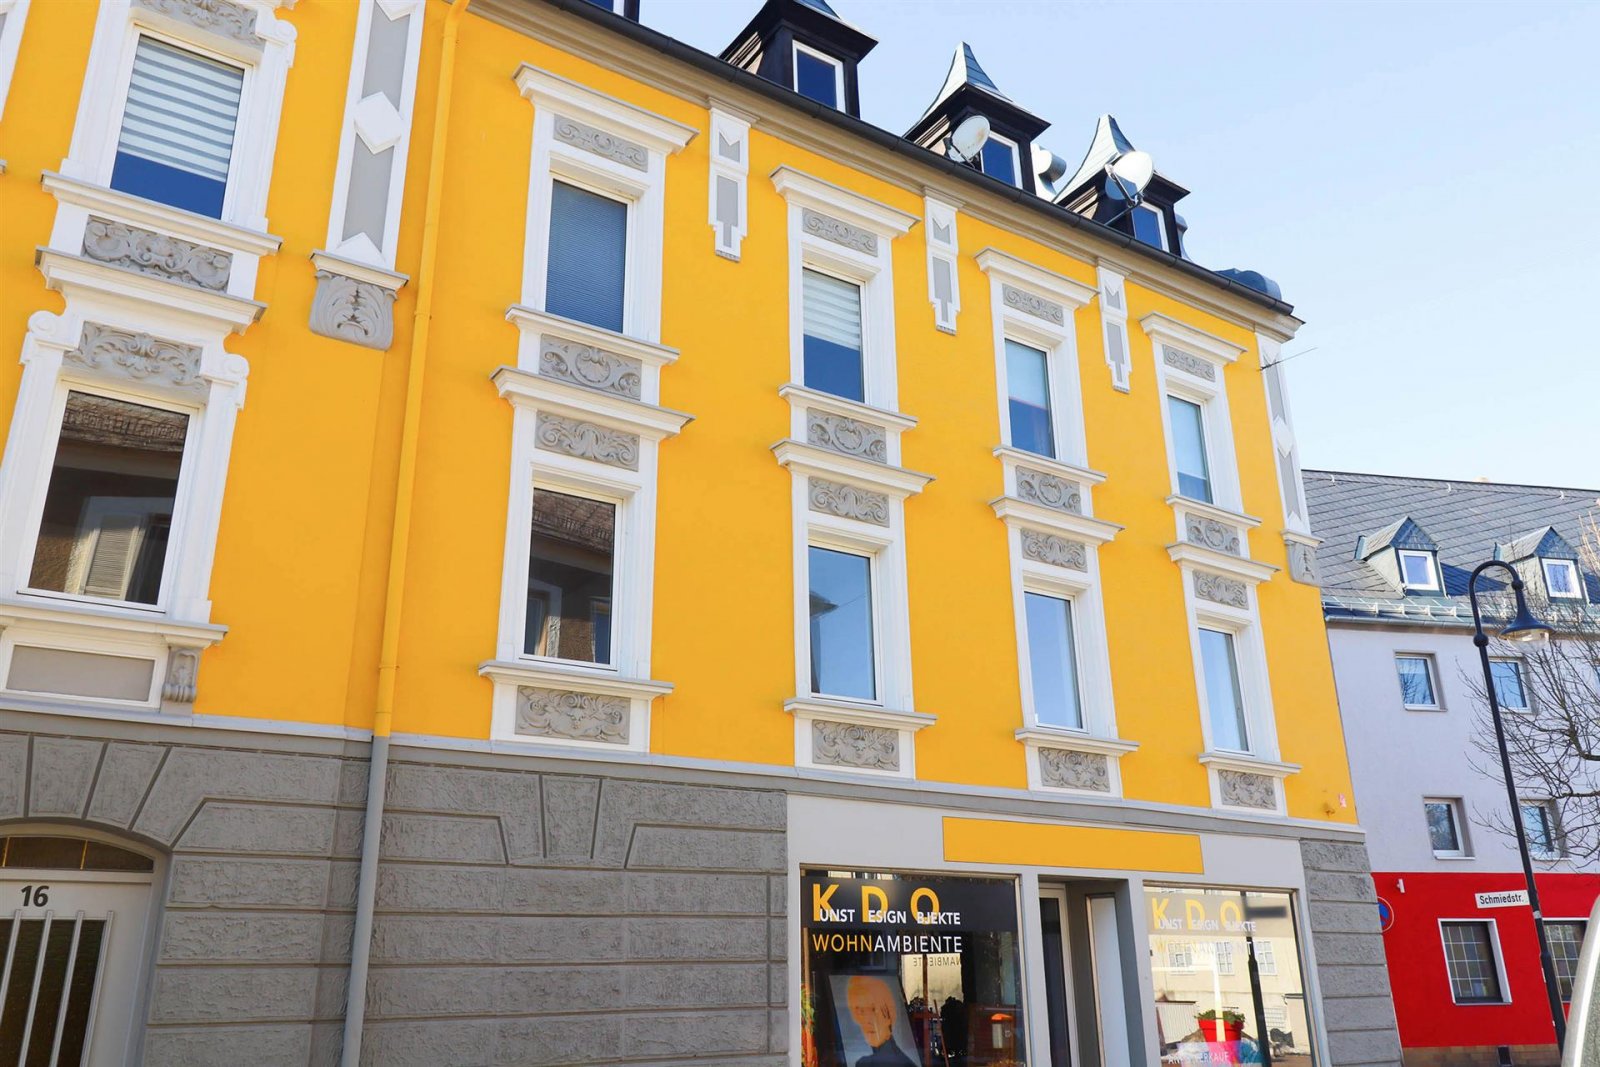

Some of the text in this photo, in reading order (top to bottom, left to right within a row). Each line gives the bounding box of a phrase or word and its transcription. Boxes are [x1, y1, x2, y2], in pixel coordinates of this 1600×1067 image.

[21, 885, 49, 907] 16
[1480, 893, 1524, 904] Schmiedstr.
[812, 934, 963, 952] WOHNAMBIENTE
